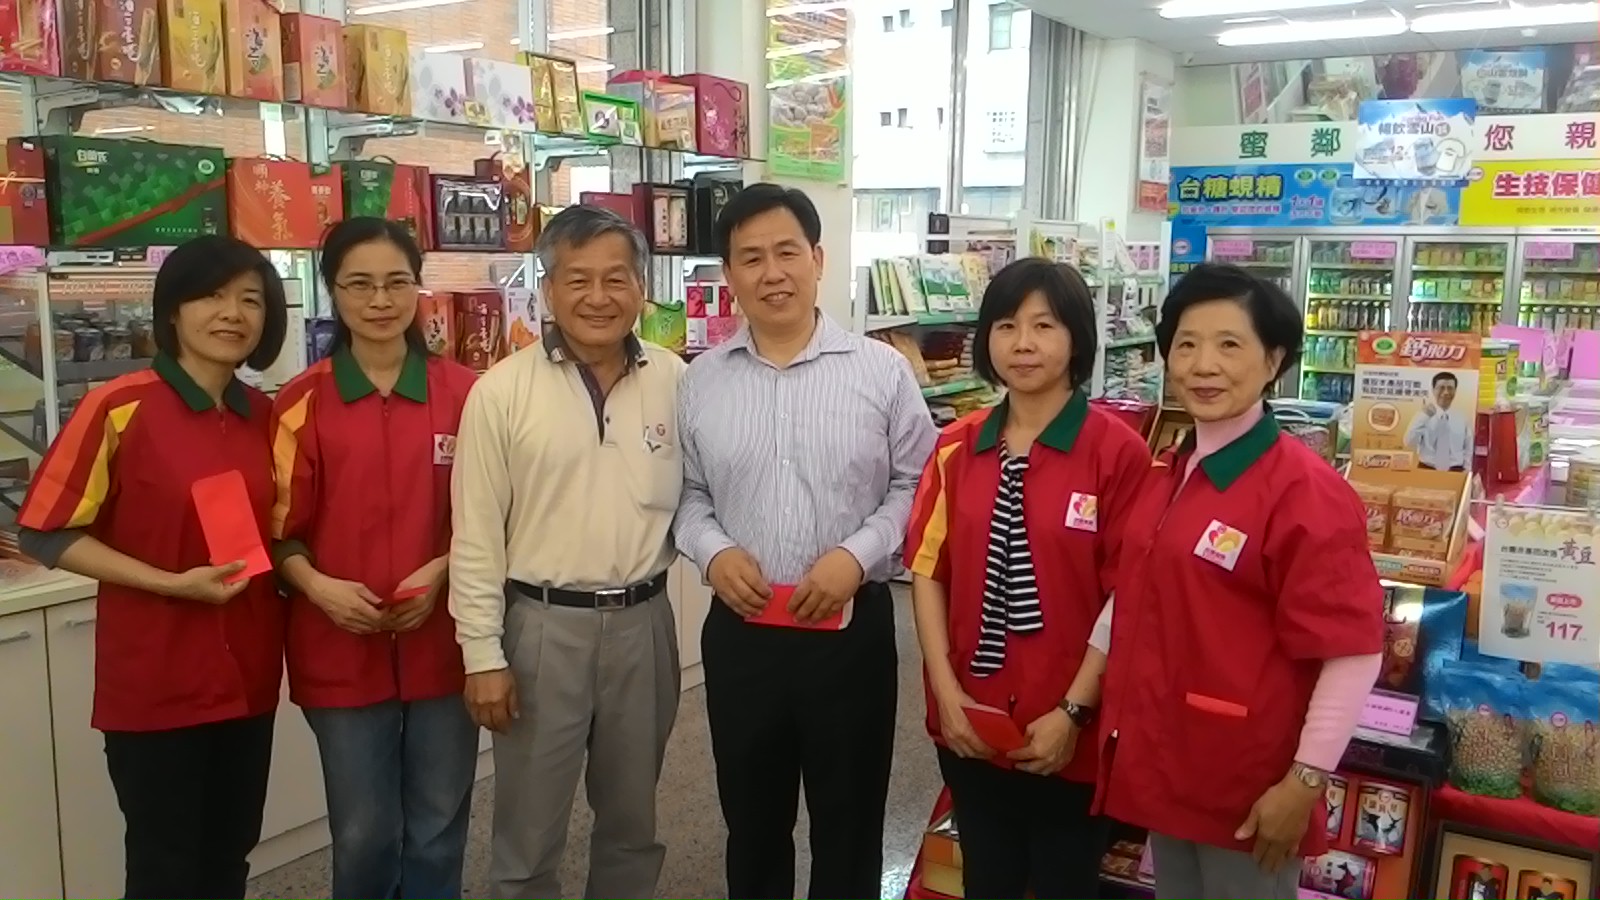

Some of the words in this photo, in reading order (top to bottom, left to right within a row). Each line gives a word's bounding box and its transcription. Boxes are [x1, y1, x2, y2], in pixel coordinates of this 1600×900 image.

[1179, 174, 1282, 199] 台糖蜆精
[1558, 538, 1596, 565] 黃豆
[1545, 621, 1583, 641] 117
